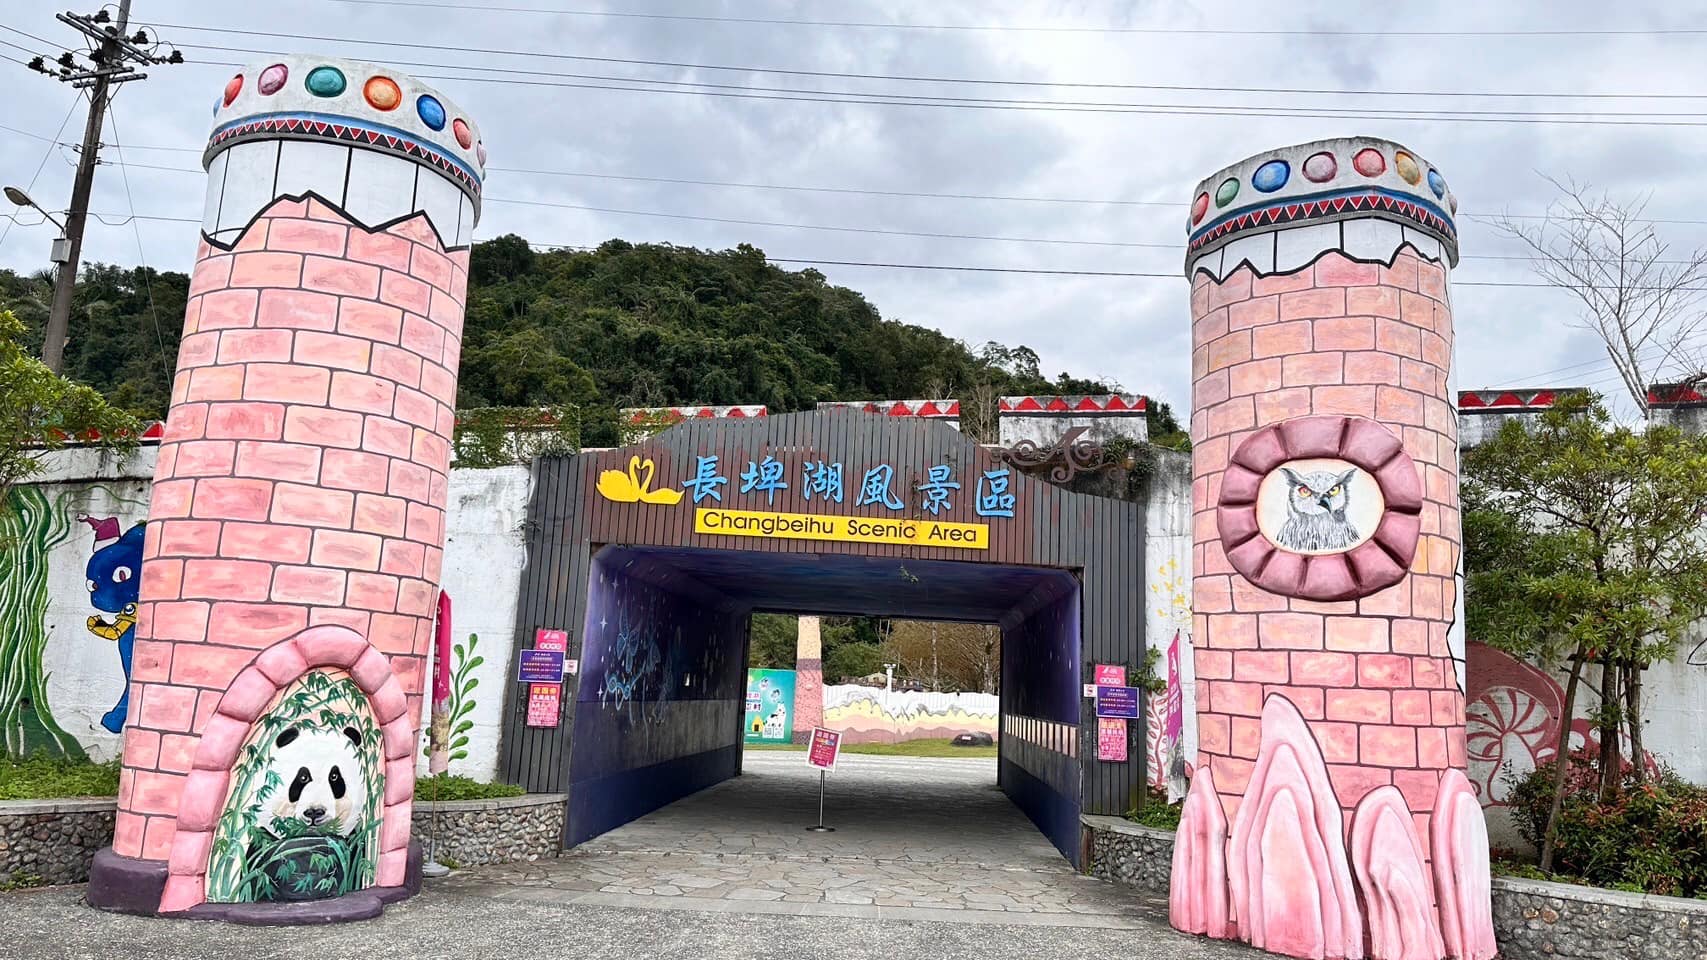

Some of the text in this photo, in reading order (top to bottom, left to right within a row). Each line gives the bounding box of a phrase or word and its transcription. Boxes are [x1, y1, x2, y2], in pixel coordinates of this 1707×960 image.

[683, 456, 1016, 517] 長埤湖風景區
[703, 511, 977, 542] Changbeihu Scenic Area
